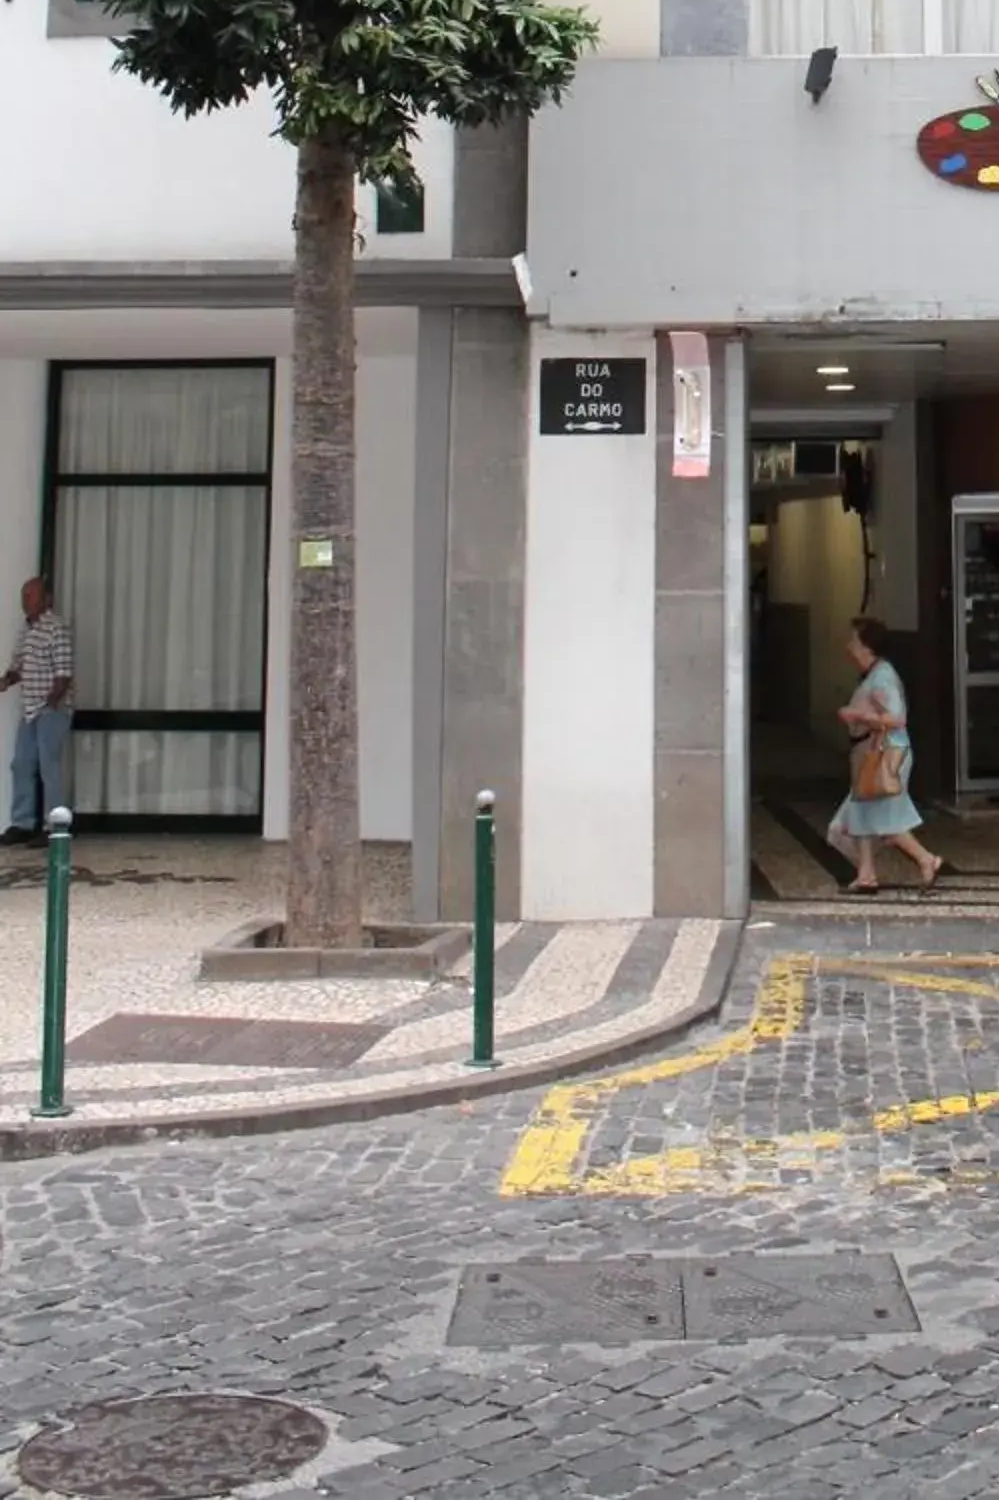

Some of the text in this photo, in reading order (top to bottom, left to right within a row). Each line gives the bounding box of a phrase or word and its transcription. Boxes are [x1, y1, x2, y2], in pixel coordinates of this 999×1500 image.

[575, 363, 611, 378] RUA
[580, 383, 603, 398] DO
[564, 402, 623, 417] CARMO
